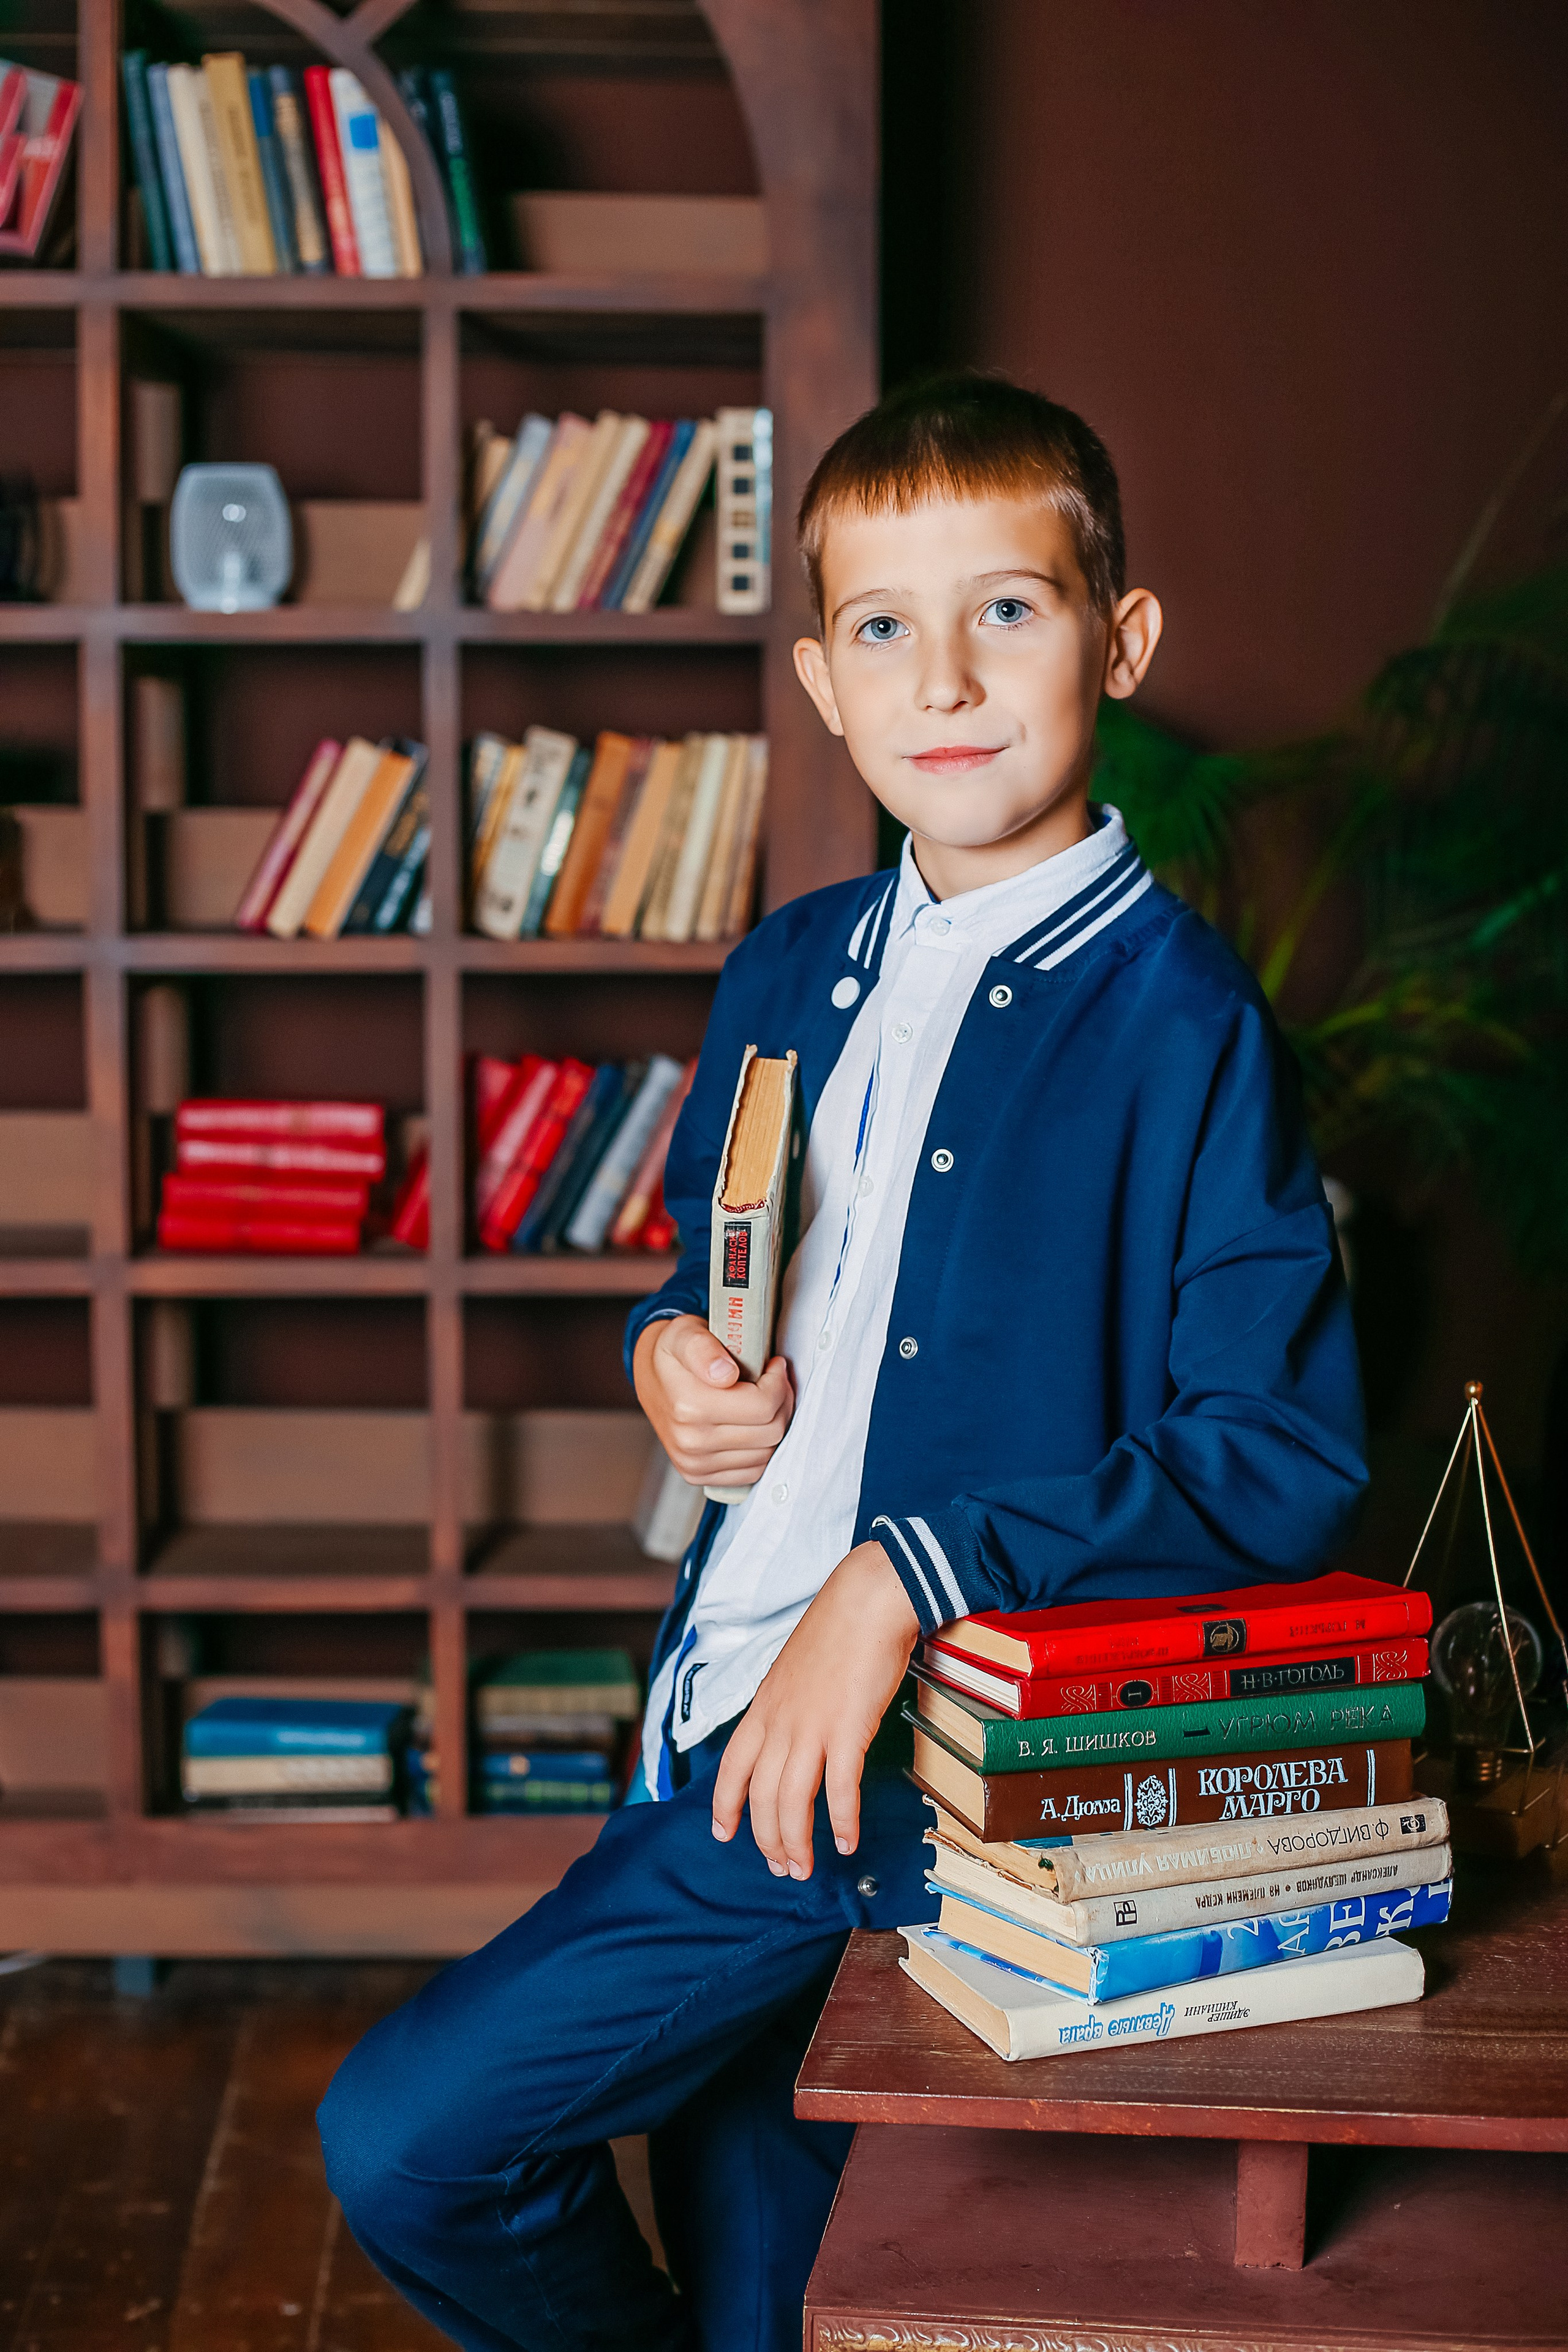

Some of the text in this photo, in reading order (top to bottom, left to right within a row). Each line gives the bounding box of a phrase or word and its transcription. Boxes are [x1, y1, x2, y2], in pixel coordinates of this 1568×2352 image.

[728, 1230, 738, 1279] АФАНАСИ
[736, 1231, 748, 1279] КОПТЕЛОВ
[1218, 1705, 1395, 1740] УГРЮМ РЕКА
[1019, 1730, 1156, 1757] В. Я. ШИШКОВ
[1197, 1757, 1348, 1796] КОРОЛЕВА
[1218, 1789, 1321, 1820] МАРГО
[1085, 1841, 1252, 1883] ЛЮБИМАЯ УЛИЦА
[1351, 1864, 1398, 1883] АЛЕКСАНДР
[1226, 1887, 1265, 1904] ПЛЕМЕНИ
[1058, 2002, 1175, 2044] Девятые врата
[1184, 2000, 1238, 2017] КИПИАНИ
[1207, 2007, 1250, 2022] ЭДИШЕР
